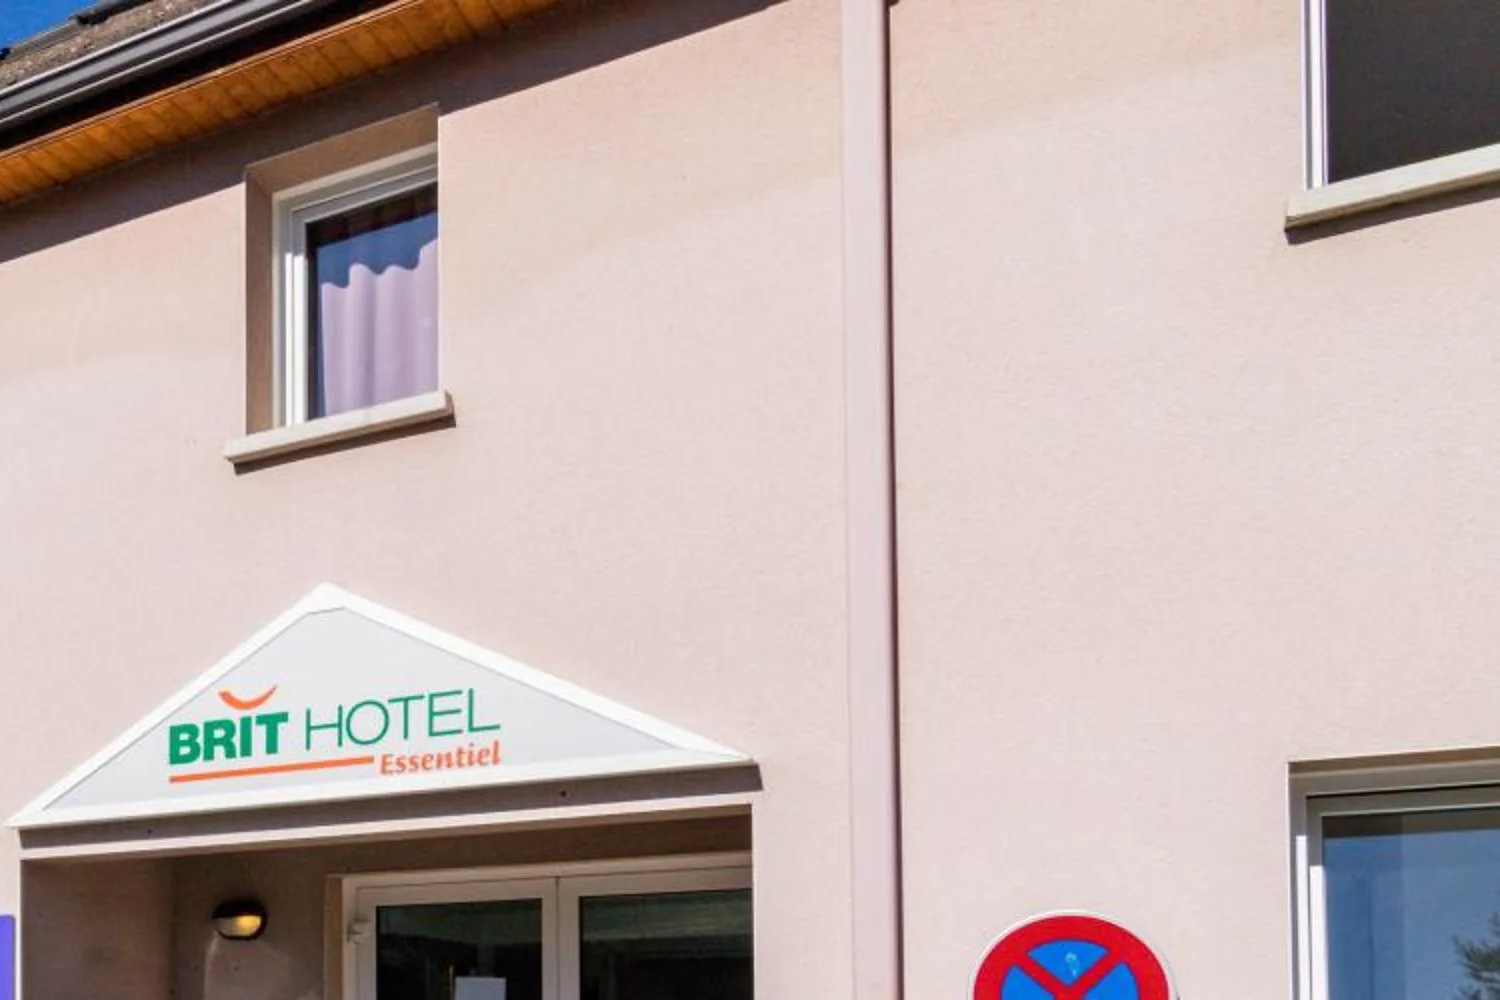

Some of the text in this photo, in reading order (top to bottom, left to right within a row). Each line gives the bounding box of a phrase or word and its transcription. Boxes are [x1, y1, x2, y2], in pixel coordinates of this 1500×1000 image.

[168, 687, 501, 765] BRIT HOTEL
[379, 740, 501, 775] Essentiel
